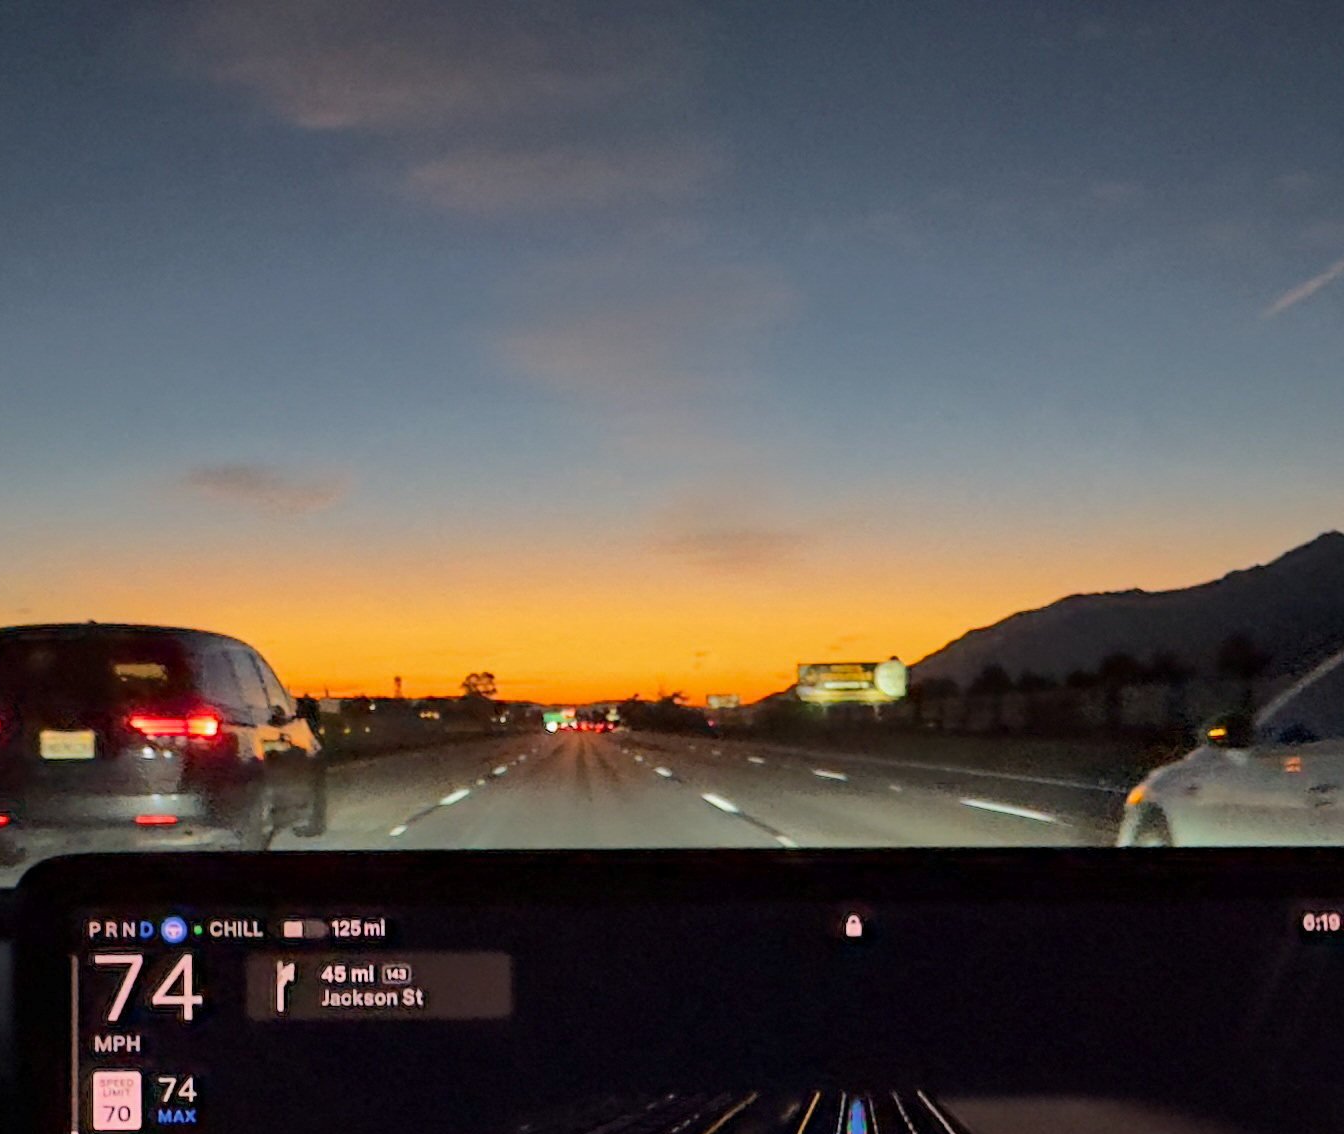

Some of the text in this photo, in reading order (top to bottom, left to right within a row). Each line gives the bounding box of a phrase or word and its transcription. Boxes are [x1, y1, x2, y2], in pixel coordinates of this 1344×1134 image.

[209, 920, 264, 937] CHILL
[332, 918, 386, 938] 125 mi
[1303, 913, 1341, 932] 6:19
[320, 965, 347, 983] 45
[351, 964, 375, 983] mi
[94, 953, 203, 1022] 74
[321, 988, 424, 1006] Jackson St
[94, 1035, 141, 1053] MPH
[99, 1079, 133, 1088] SPEED
[158, 1077, 198, 1103] 74
[102, 1088, 131, 1098] LIMIT
[103, 1105, 131, 1123] 70
[158, 1108, 197, 1124] MAX
